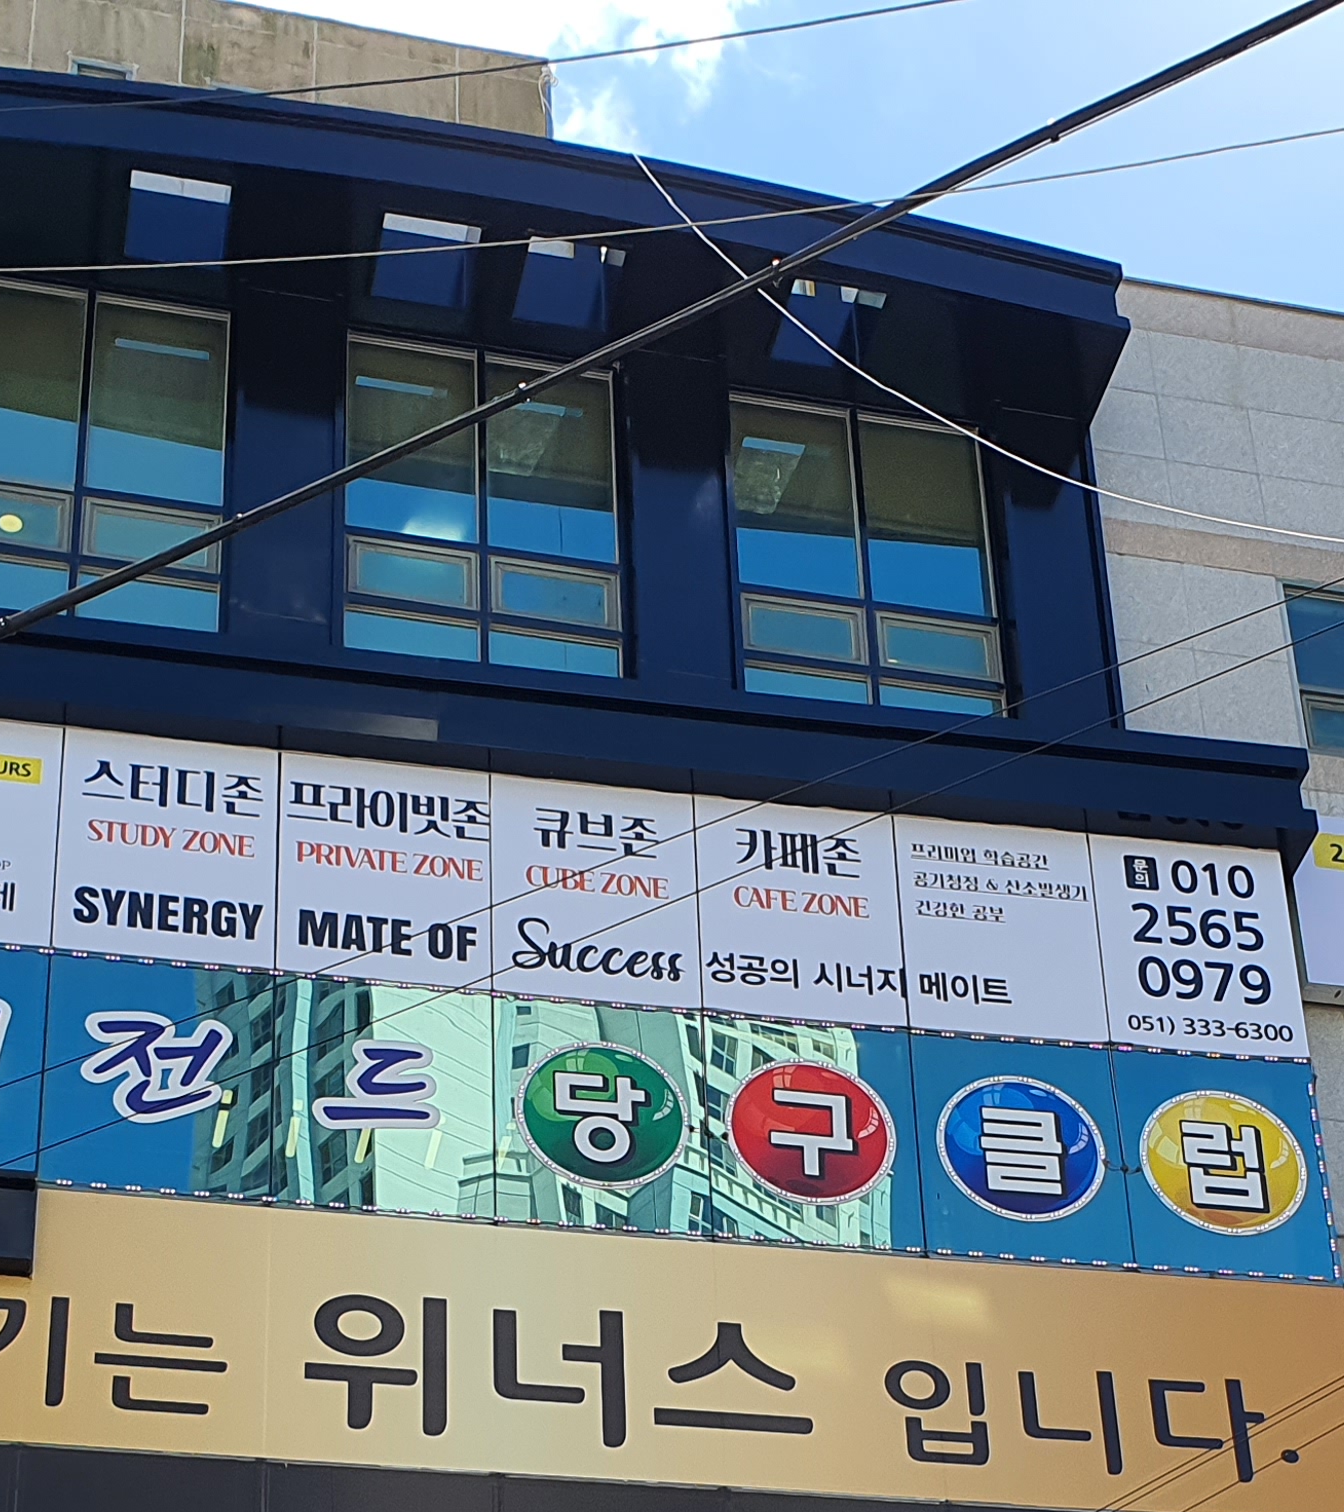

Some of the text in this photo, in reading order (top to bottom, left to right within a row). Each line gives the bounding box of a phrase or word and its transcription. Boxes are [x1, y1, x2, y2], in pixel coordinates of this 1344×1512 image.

[82, 760, 263, 818] 스터디존
[287, 781, 489, 841] 프라이빗존
[87, 819, 255, 859] STUDY ZONE
[533, 807, 659, 859] 큐브존
[734, 828, 861, 878] 카페존
[296, 840, 484, 882] PRIVATE ZONE
[983, 848, 1049, 870] 학습공간
[1170, 859, 1255, 899] 010
[525, 865, 669, 900] CUBE ZONE
[733, 886, 870, 919] CAFE ZONE
[986, 878, 999, 891] &
[73, 886, 685, 982] SYNERGY MATE OF Success
[915, 900, 1005, 923] 건강한 공부
[1131, 902, 1264, 952] 2565
[706, 951, 1013, 1005] 성공의 시너지 메이트
[1138, 956, 1272, 1005] 0979
[1128, 1014, 1293, 1043] 051) 333-6300
[302, 1292, 814, 1449] 위너스
[883, 1358, 1300, 1484] 입니다.
